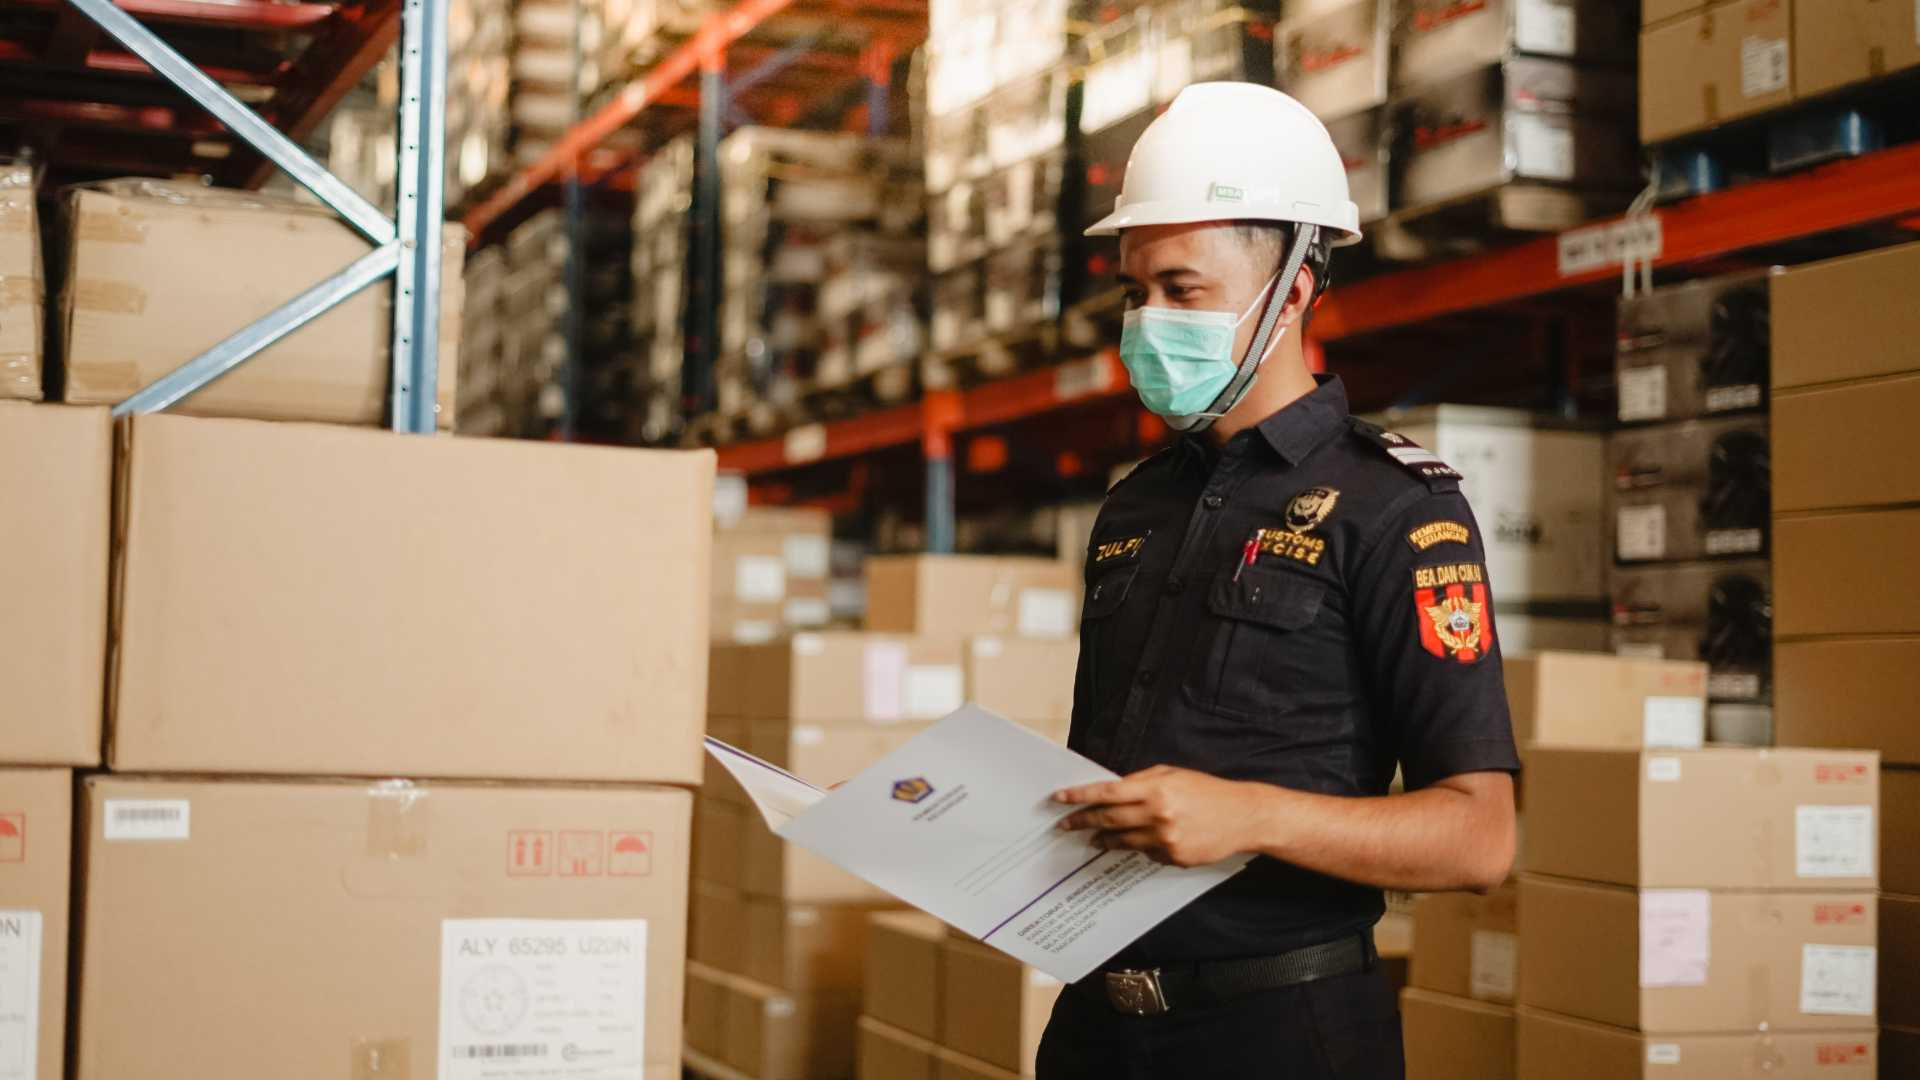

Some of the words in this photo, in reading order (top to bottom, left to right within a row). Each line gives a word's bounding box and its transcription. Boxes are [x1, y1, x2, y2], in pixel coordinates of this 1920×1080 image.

[1261, 529, 1325, 551] USTOMS
[1262, 541, 1319, 566] XCISE
[1416, 567, 1437, 588] BEA
[1437, 565, 1458, 584] DAN
[459, 936, 497, 954] ALY
[578, 935, 631, 954] U20N
